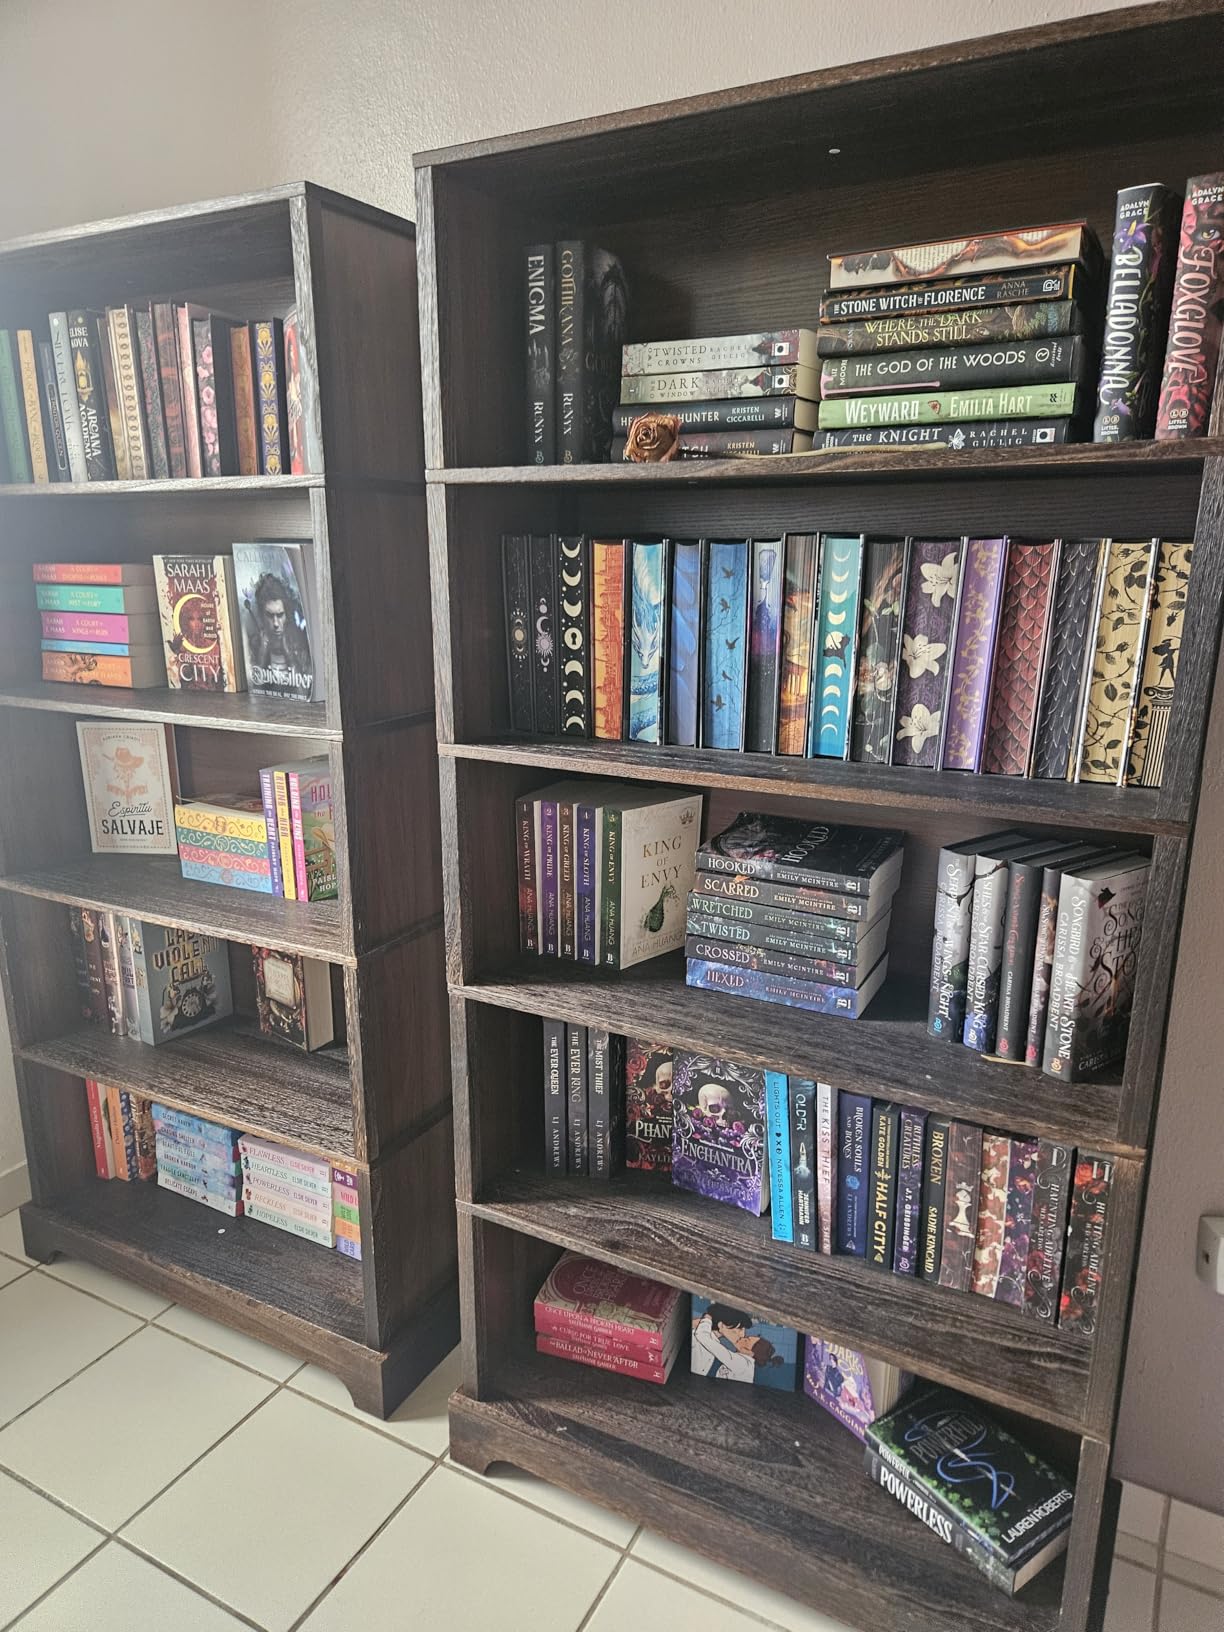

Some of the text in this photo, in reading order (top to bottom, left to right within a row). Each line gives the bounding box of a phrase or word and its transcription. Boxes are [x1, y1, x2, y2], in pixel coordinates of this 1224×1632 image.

[1120, 199, 1150, 212] ADALYN
[1191, 195, 1223, 206] GRACE
[1119, 208, 1149, 219] GRACE
[528, 255, 545, 336] ENIGMA
[996, 287, 1029, 299] RASCHE
[1001, 281, 1026, 290] ANNA
[840, 286, 986, 315] STONE WITCH FLORENCE
[864, 310, 982, 333] WHERE DARK
[1100, 246, 1144, 405] BELLADONNA
[1168, 247, 1218, 383] FOXGLOVE
[876, 325, 971, 347] STANDS STILL
[653, 345, 708, 358] TWISTED
[657, 357, 702, 367] CROWNS
[855, 350, 1027, 377] THE GOD OF THE WOODS
[657, 377, 700, 391] DARK
[660, 391, 696, 399] WINDOW
[563, 392, 574, 435] RUNYX
[679, 411, 720, 424] HUNTER
[726, 414, 765, 424] CICCARELLI
[731, 406, 760, 415] KRISTEN
[845, 393, 1033, 425] WEYWARD EMILIA HART
[79, 403, 93, 461] ACADEMY
[86, 406, 102, 458] ARCANA
[878, 427, 943, 443] KNIGHT
[969, 428, 1028, 438] RACHEL
[727, 441, 756, 450] KRISTEN
[166, 563, 215, 580] SARAH J.
[174, 578, 211, 593] MAAS
[178, 653, 220, 664] CRESCENT
[179, 664, 221, 683] CITY
[261, 774, 276, 841] TRAINING HEART
[102, 819, 164, 835] SALVAJE
[642, 835, 682, 859] KING
[781, 826, 830, 863] HOOKED
[523, 848, 531, 881] WRATH
[607, 831, 616, 884] KING ENVY
[656, 856, 668, 867] OF
[708, 857, 755, 875] HOOKED
[583, 857, 591, 886] SLOTH
[641, 864, 683, 889] ENVY
[776, 872, 800, 882] EMILY
[803, 878, 839, 888] MCINTIRE
[704, 878, 760, 899] SCARRED
[691, 898, 753, 920] WRETCHED
[774, 894, 797, 904] EMILY
[798, 898, 836, 911] MCINTIRE
[584, 915, 592, 942] HUANG
[608, 919, 616, 945] HUANG
[700, 921, 751, 941] TWISTED
[764, 914, 825, 931] EMILY MCINTIRE
[632, 930, 684, 957] ANA HUANG
[695, 943, 751, 964] CROSSED
[765, 936, 826, 954] EMILY MCINTIRE
[763, 958, 824, 976] EMILY MCINTIRE
[931, 930, 943, 992] BROADBENT
[942, 938, 955, 976] WINGS
[706, 970, 745, 987] HEXED
[966, 937, 977, 1004] BROADBENT
[1049, 912, 1070, 1031] CARISSA BROADBENT
[1057, 896, 1087, 1060] SONGBIRD HEART STONE
[971, 1000, 986, 1030] KING
[550, 1048, 558, 1070] EVER
[570, 1031, 581, 1104] THE EVER KING
[550, 1070, 560, 1095] QUEEN
[594, 1050, 604, 1095] MIST THIEF
[796, 1093, 806, 1131] OLDER
[821, 1118, 830, 1144] KISS
[879, 1114, 887, 1136] KATE
[844, 1129, 853, 1160] BONES
[854, 1106, 864, 1173] BROKEN SOULS
[902, 1119, 912, 1170] CREATURES
[912, 1124, 922, 1169] RUTHLESS
[249, 1146, 285, 1165] FLAWLESS
[680, 1139, 752, 1174] ENCHANTRA
[877, 1137, 886, 1168] GOLDEN
[930, 1130, 945, 1185] BROKEN
[251, 1161, 288, 1180] HEARTLESS
[821, 1150, 830, 1184] THIEF
[252, 1176, 290, 1196] POWERLESS
[254, 1194, 287, 1211] RECKLESS
[876, 1180, 889, 1224] HALF
[1045, 1183, 1060, 1237] HAUNTING
[256, 1209, 288, 1228] HOPELESS
[874, 1224, 887, 1255] CITY
[924, 1205, 938, 1274] SADIE KINCAID
[1086, 1248, 1100, 1296] ADELINE
[563, 1308, 582, 1321] UPON
[579, 1332, 592, 1341] FOR
[612, 1341, 630, 1352] LOVE
[555, 1341, 583, 1355] BALLAD
[587, 1349, 613, 1362] NEVER
[613, 1356, 639, 1369] AFTER
[910, 1414, 985, 1465] POWERFUL
[878, 1443, 912, 1481] POWERFUL
[879, 1466, 953, 1544] POWERLESS
[1001, 1489, 1074, 1544] LAUREN ROBERTS
